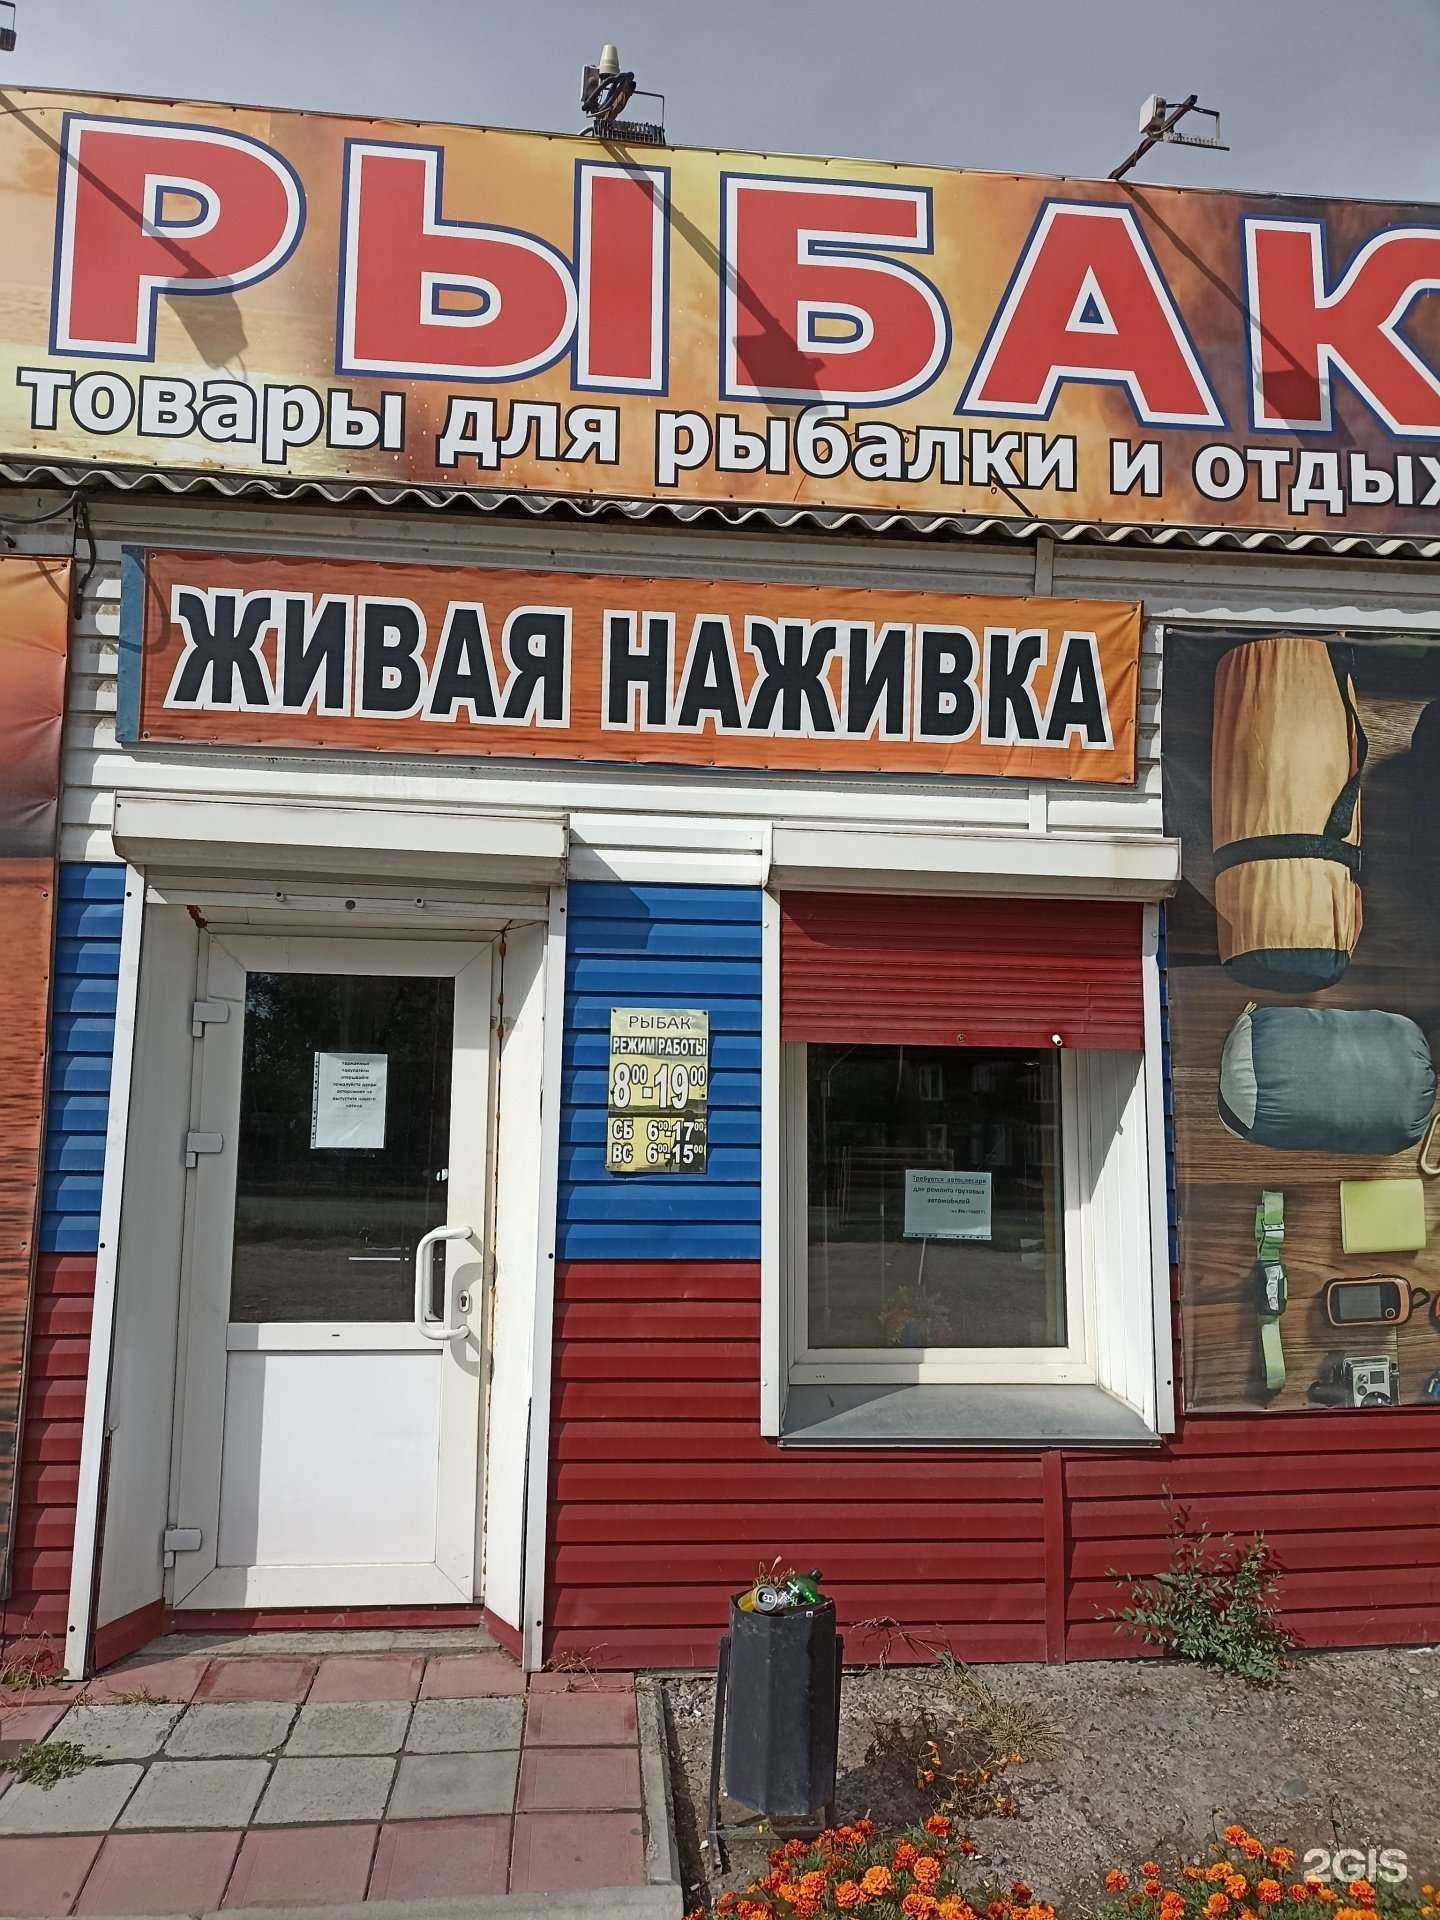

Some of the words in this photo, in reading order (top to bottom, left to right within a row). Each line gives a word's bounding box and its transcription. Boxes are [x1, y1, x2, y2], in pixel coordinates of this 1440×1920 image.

[49, 112, 1440, 440] РЫБАК
[17, 366, 405, 465] товары
[436, 395, 621, 470] для
[654, 404, 1078, 491] рыбалки
[1110, 438, 1164, 496] и
[163, 584, 573, 728] ЖИВАЯ
[601, 609, 1115, 750] НАЖИВКА
[628, 1015, 692, 1030] РЫБАК
[612, 1036, 656, 1055] РЕЖИМ
[657, 1037, 707, 1056] РАБОТЫ
[612, 1119, 634, 1141] СБ
[611, 1143, 633, 1164] ВС
